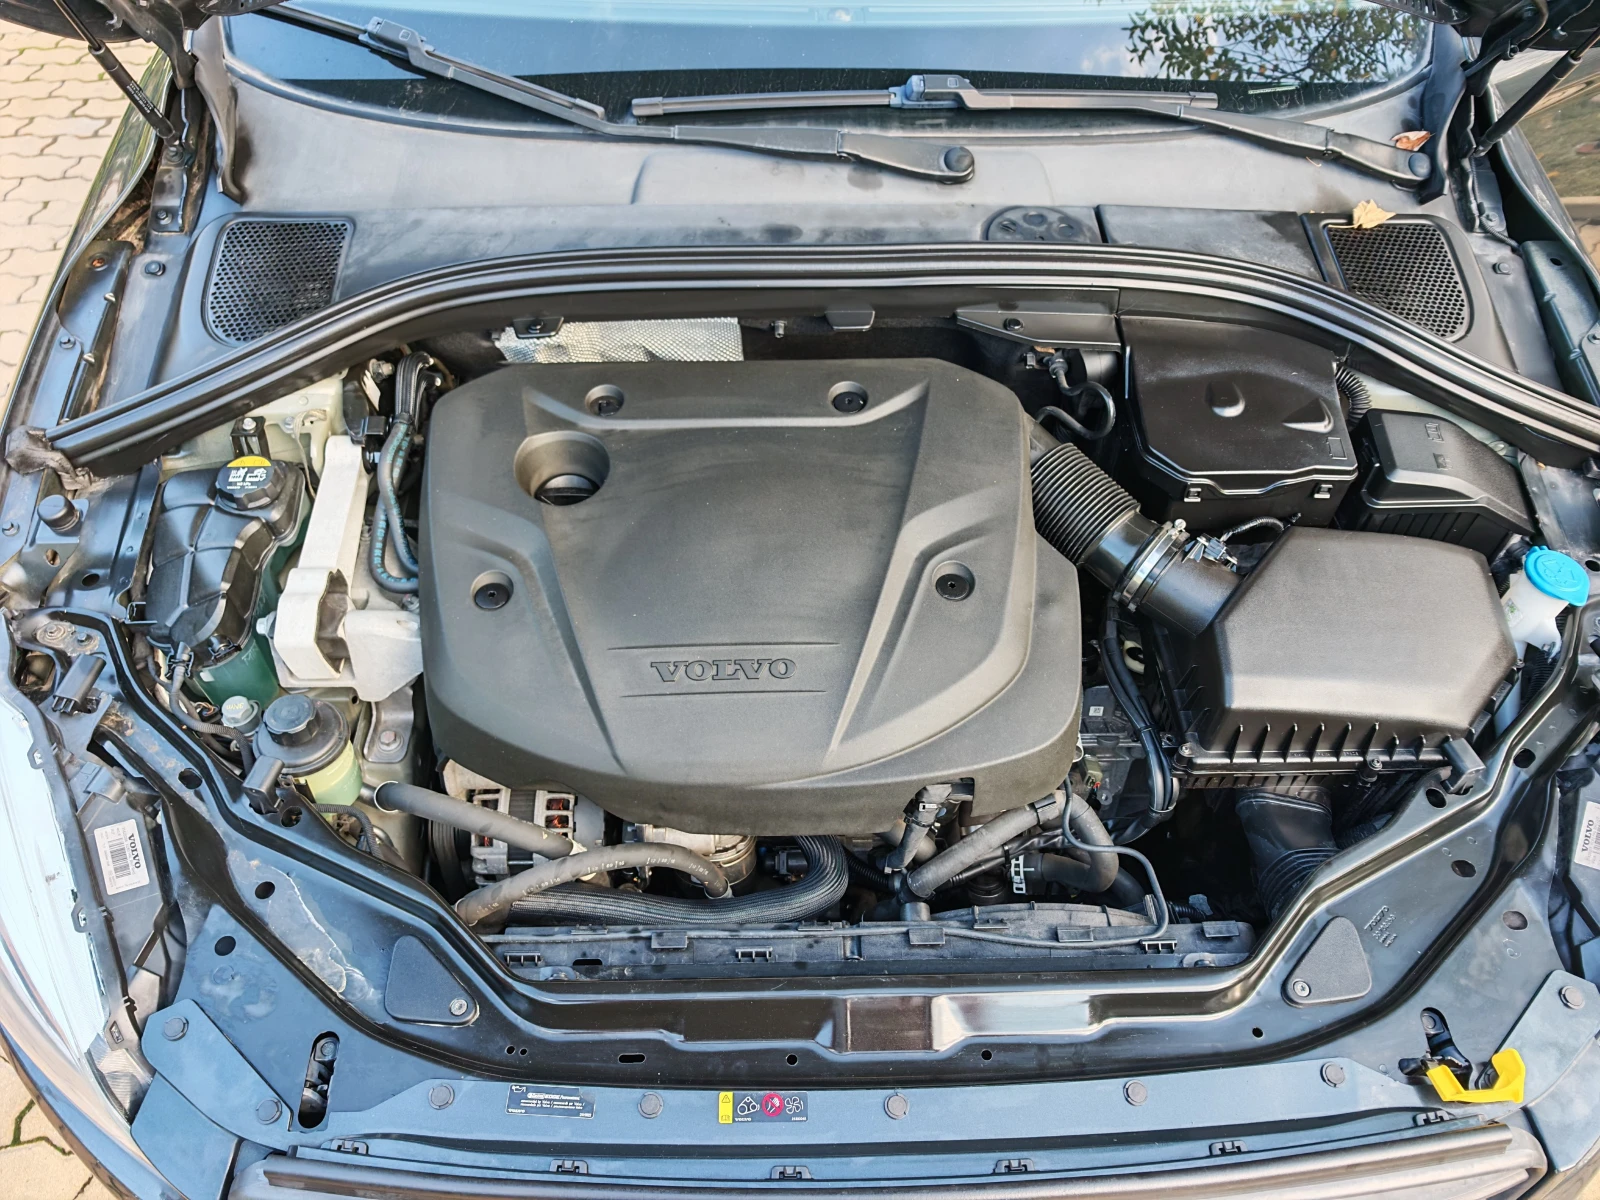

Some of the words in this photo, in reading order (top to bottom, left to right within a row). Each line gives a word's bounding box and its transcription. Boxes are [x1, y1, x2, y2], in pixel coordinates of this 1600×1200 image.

[651, 658, 797, 682] VOLVO
[128, 833, 141, 869] VOLVO
[1581, 819, 1595, 852] VOLVO
